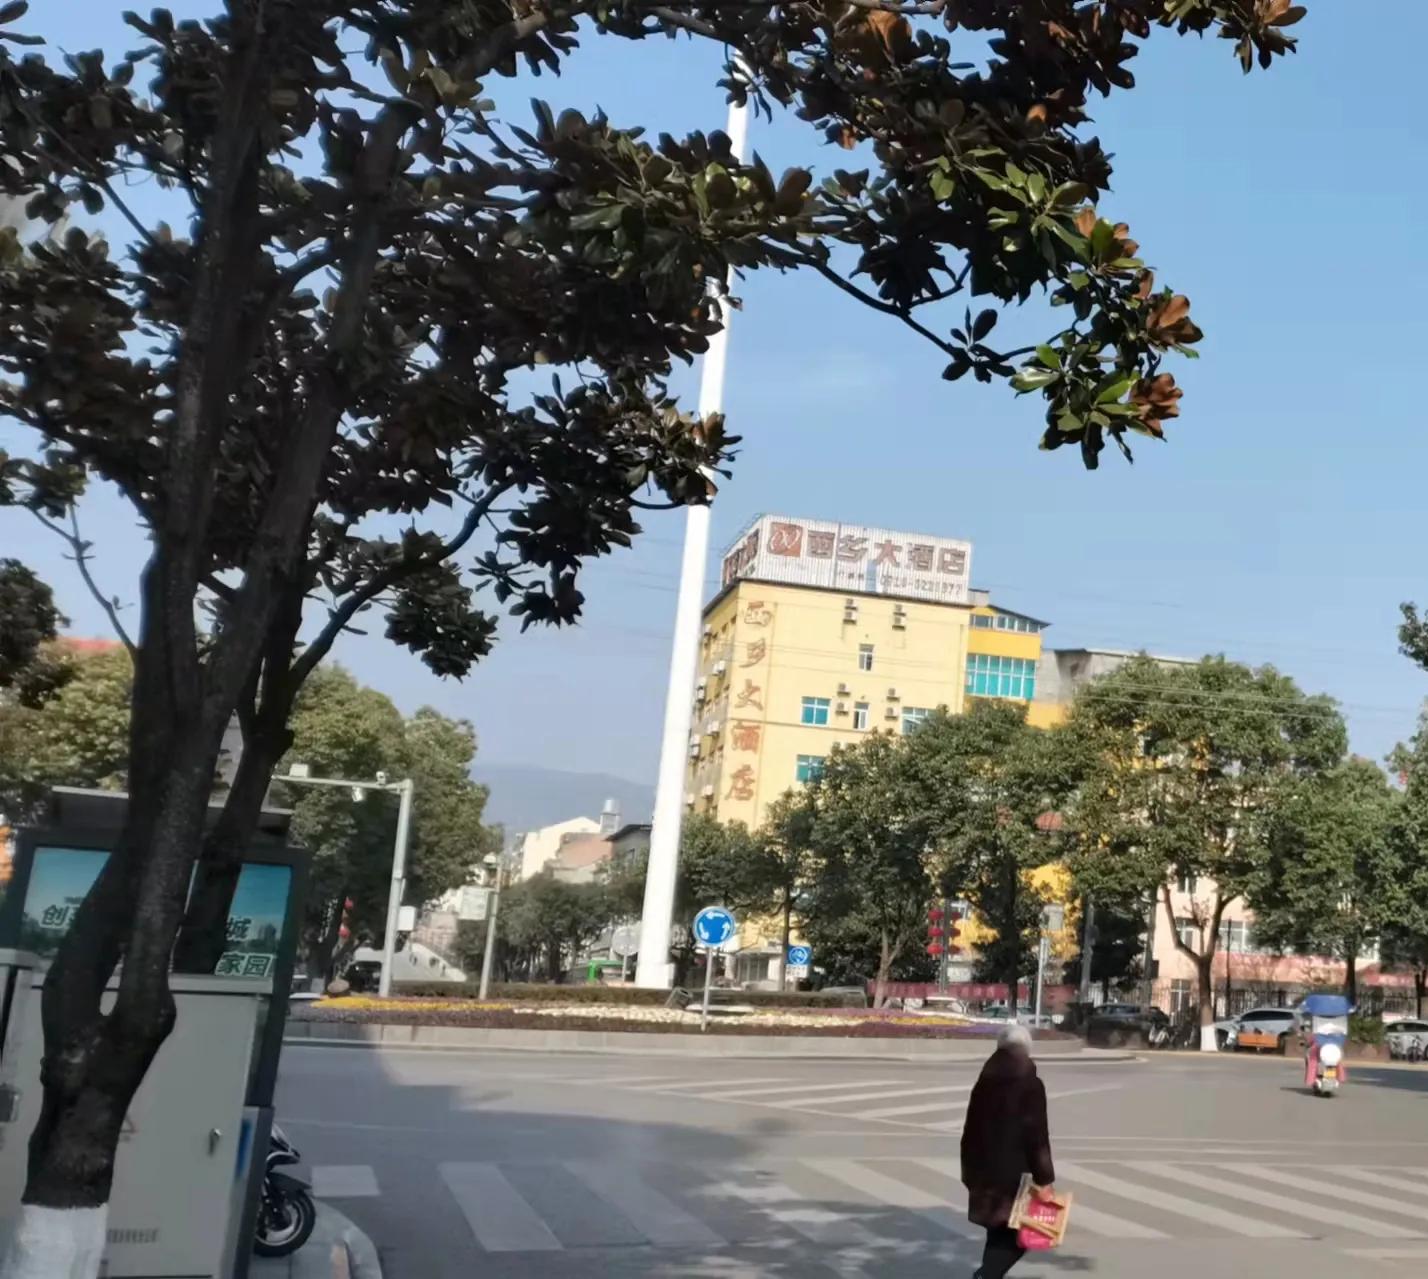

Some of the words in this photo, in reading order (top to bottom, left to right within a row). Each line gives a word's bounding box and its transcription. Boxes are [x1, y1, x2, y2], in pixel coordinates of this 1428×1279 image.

[725, 601, 772, 801] 西乡大酒店
